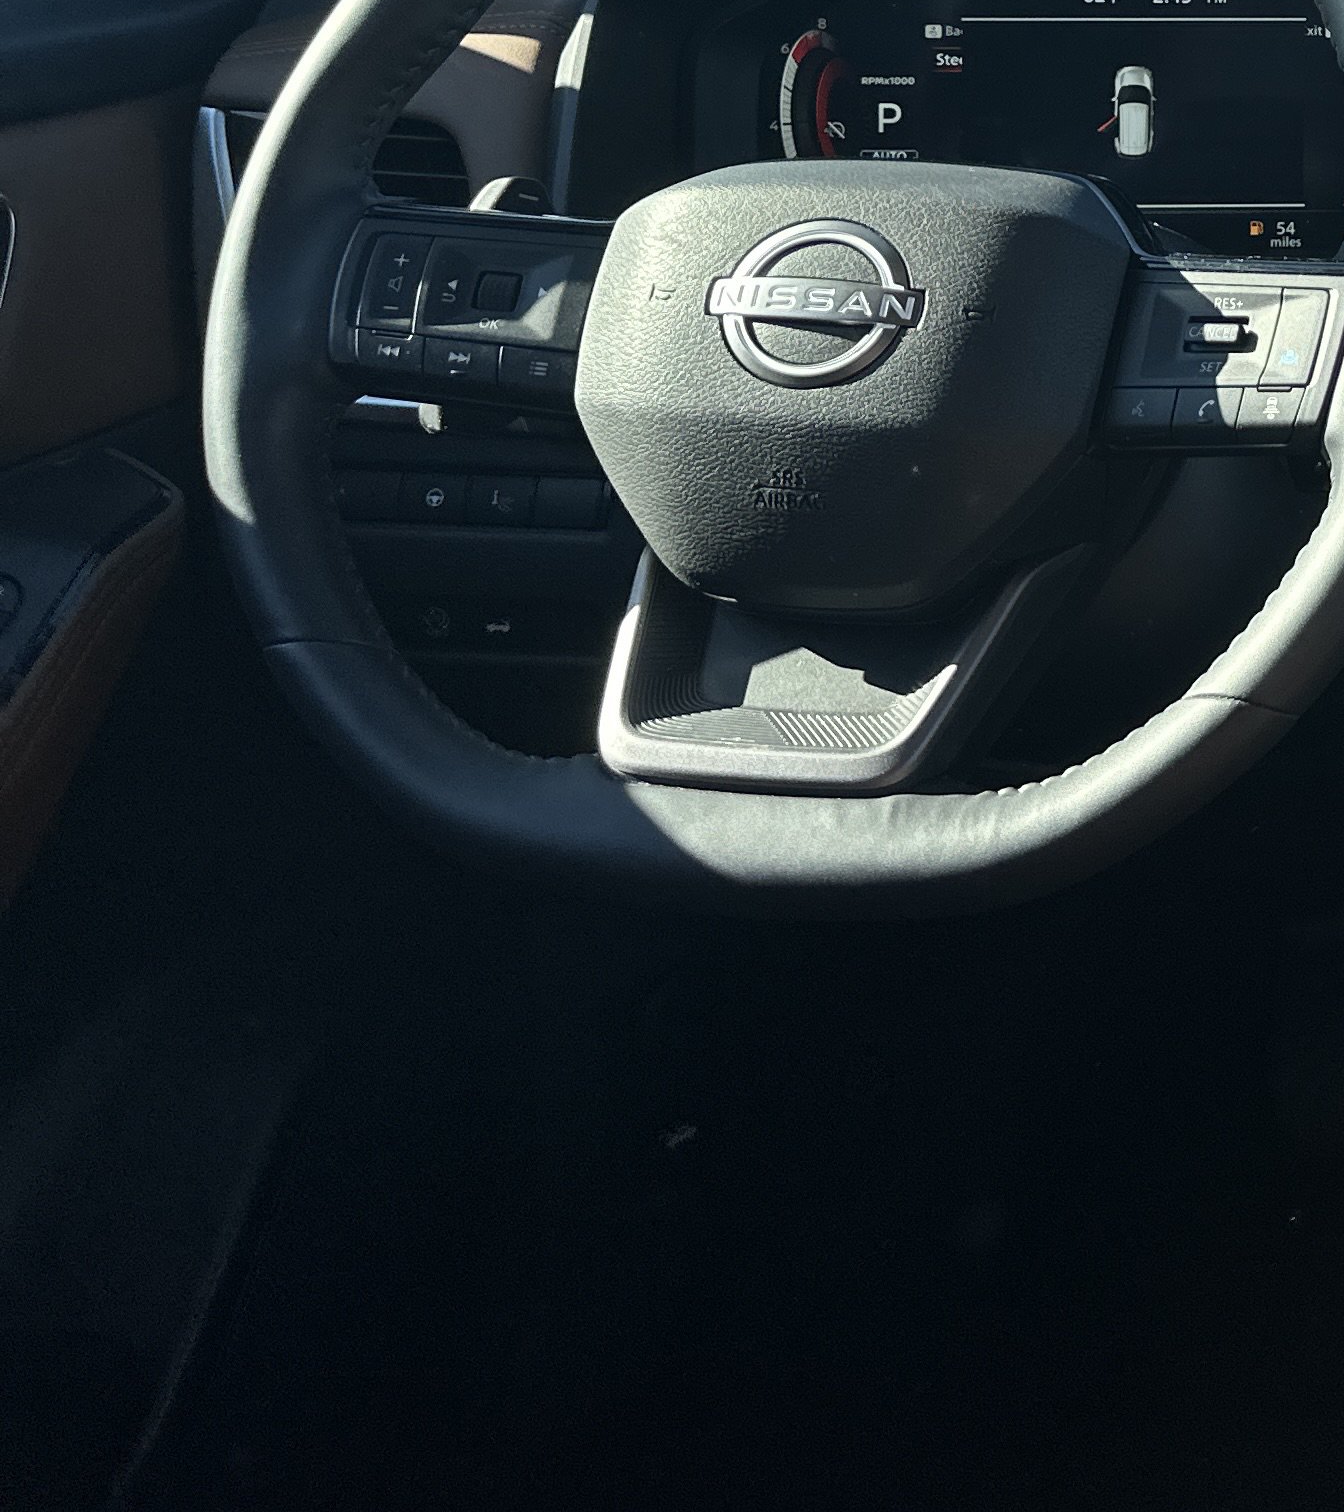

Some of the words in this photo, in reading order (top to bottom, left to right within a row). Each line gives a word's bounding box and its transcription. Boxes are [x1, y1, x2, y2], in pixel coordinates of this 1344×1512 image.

[817, 17, 827, 29] 8
[781, 42, 790, 54] 6
[861, 76, 916, 85] RPMx1000
[877, 102, 902, 133] P
[1276, 221, 1295, 235] 54
[1270, 236, 1301, 248] miles
[716, 284, 916, 320] NISSAN
[1214, 297, 1243, 309] RES+
[479, 317, 499, 329] OK
